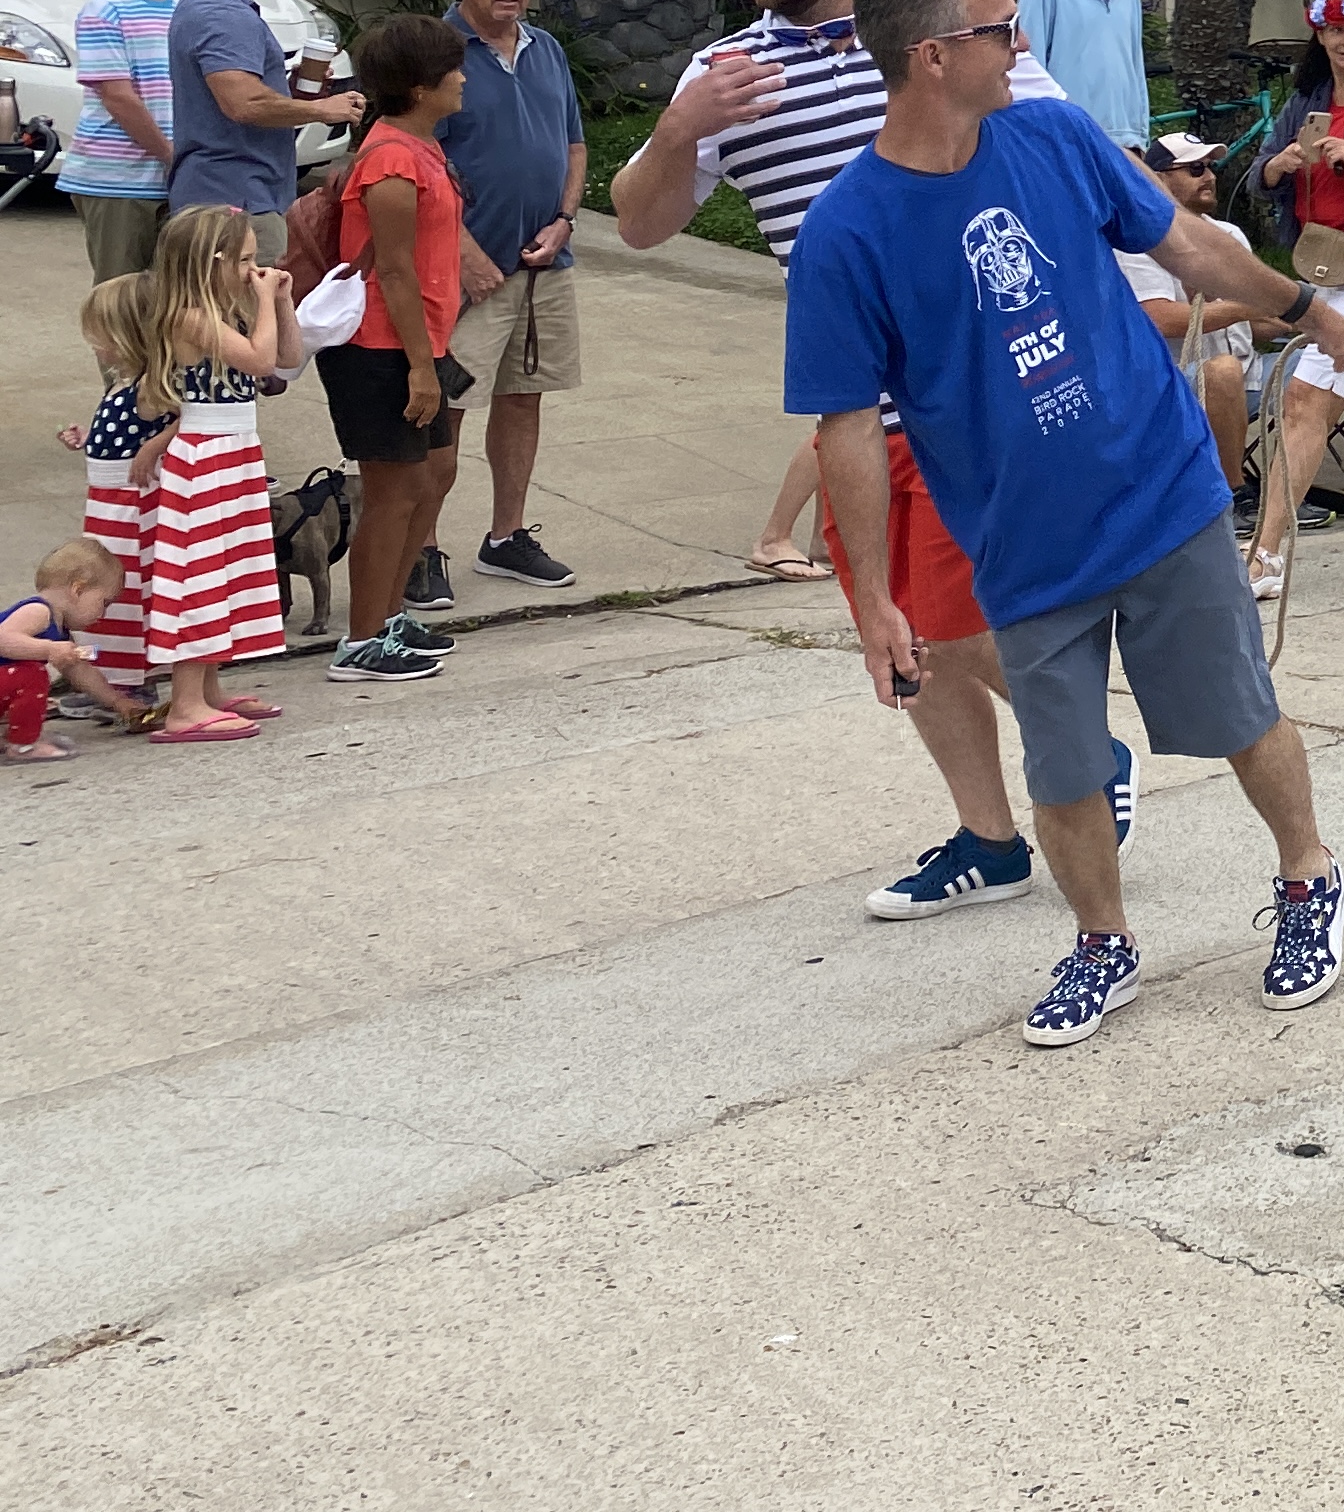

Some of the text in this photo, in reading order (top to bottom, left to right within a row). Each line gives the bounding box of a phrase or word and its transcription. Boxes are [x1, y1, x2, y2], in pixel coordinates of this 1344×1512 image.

[1009, 332, 1038, 353] 4TH
[1040, 319, 1059, 338] OF
[1015, 332, 1065, 377] JULY
[1053, 375, 1082, 394] ANNUAL
[1059, 383, 1085, 402] ROCK
[1038, 392, 1092, 425] PARADE
[1041, 399, 1093, 435] 2021
